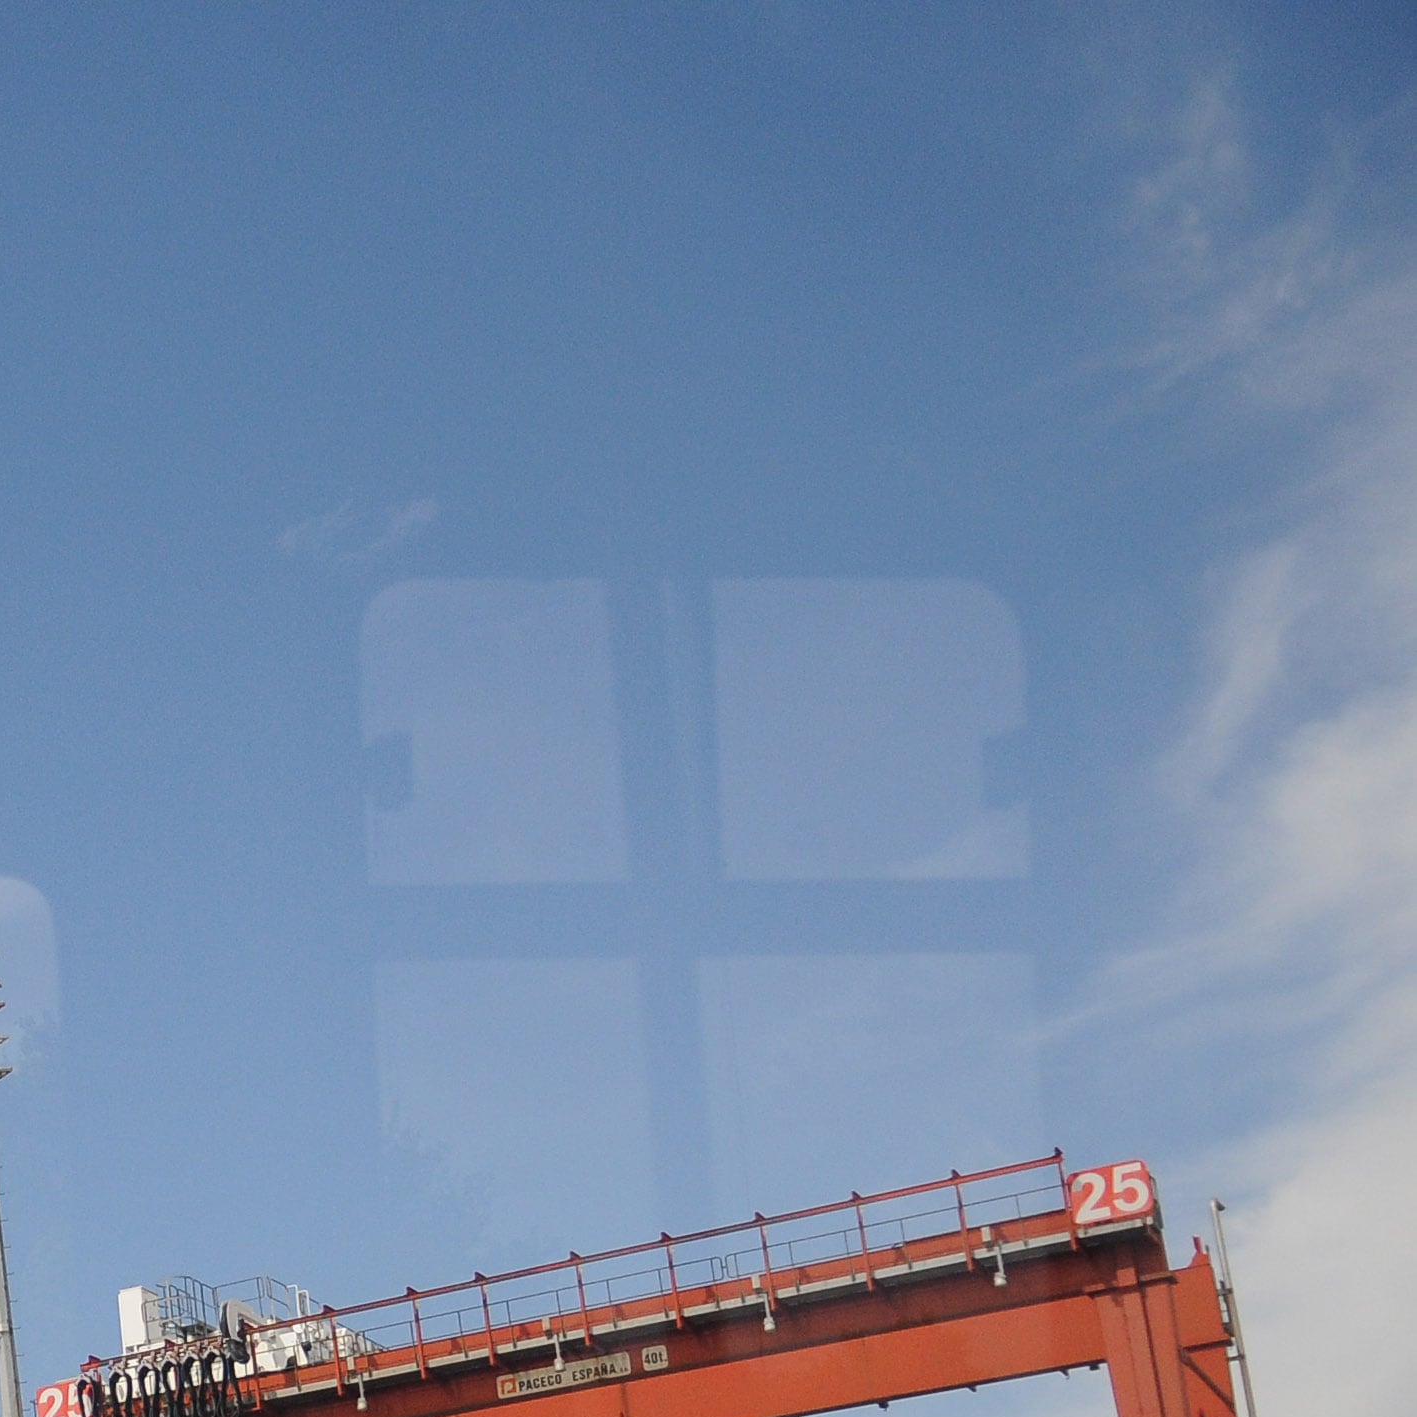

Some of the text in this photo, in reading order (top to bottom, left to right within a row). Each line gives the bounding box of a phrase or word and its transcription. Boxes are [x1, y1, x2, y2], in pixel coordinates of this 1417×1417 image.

[1072, 1161, 1150, 1225] 25
[518, 1373, 562, 1391] PACECO
[572, 1363, 615, 1382] ESPAÑA
